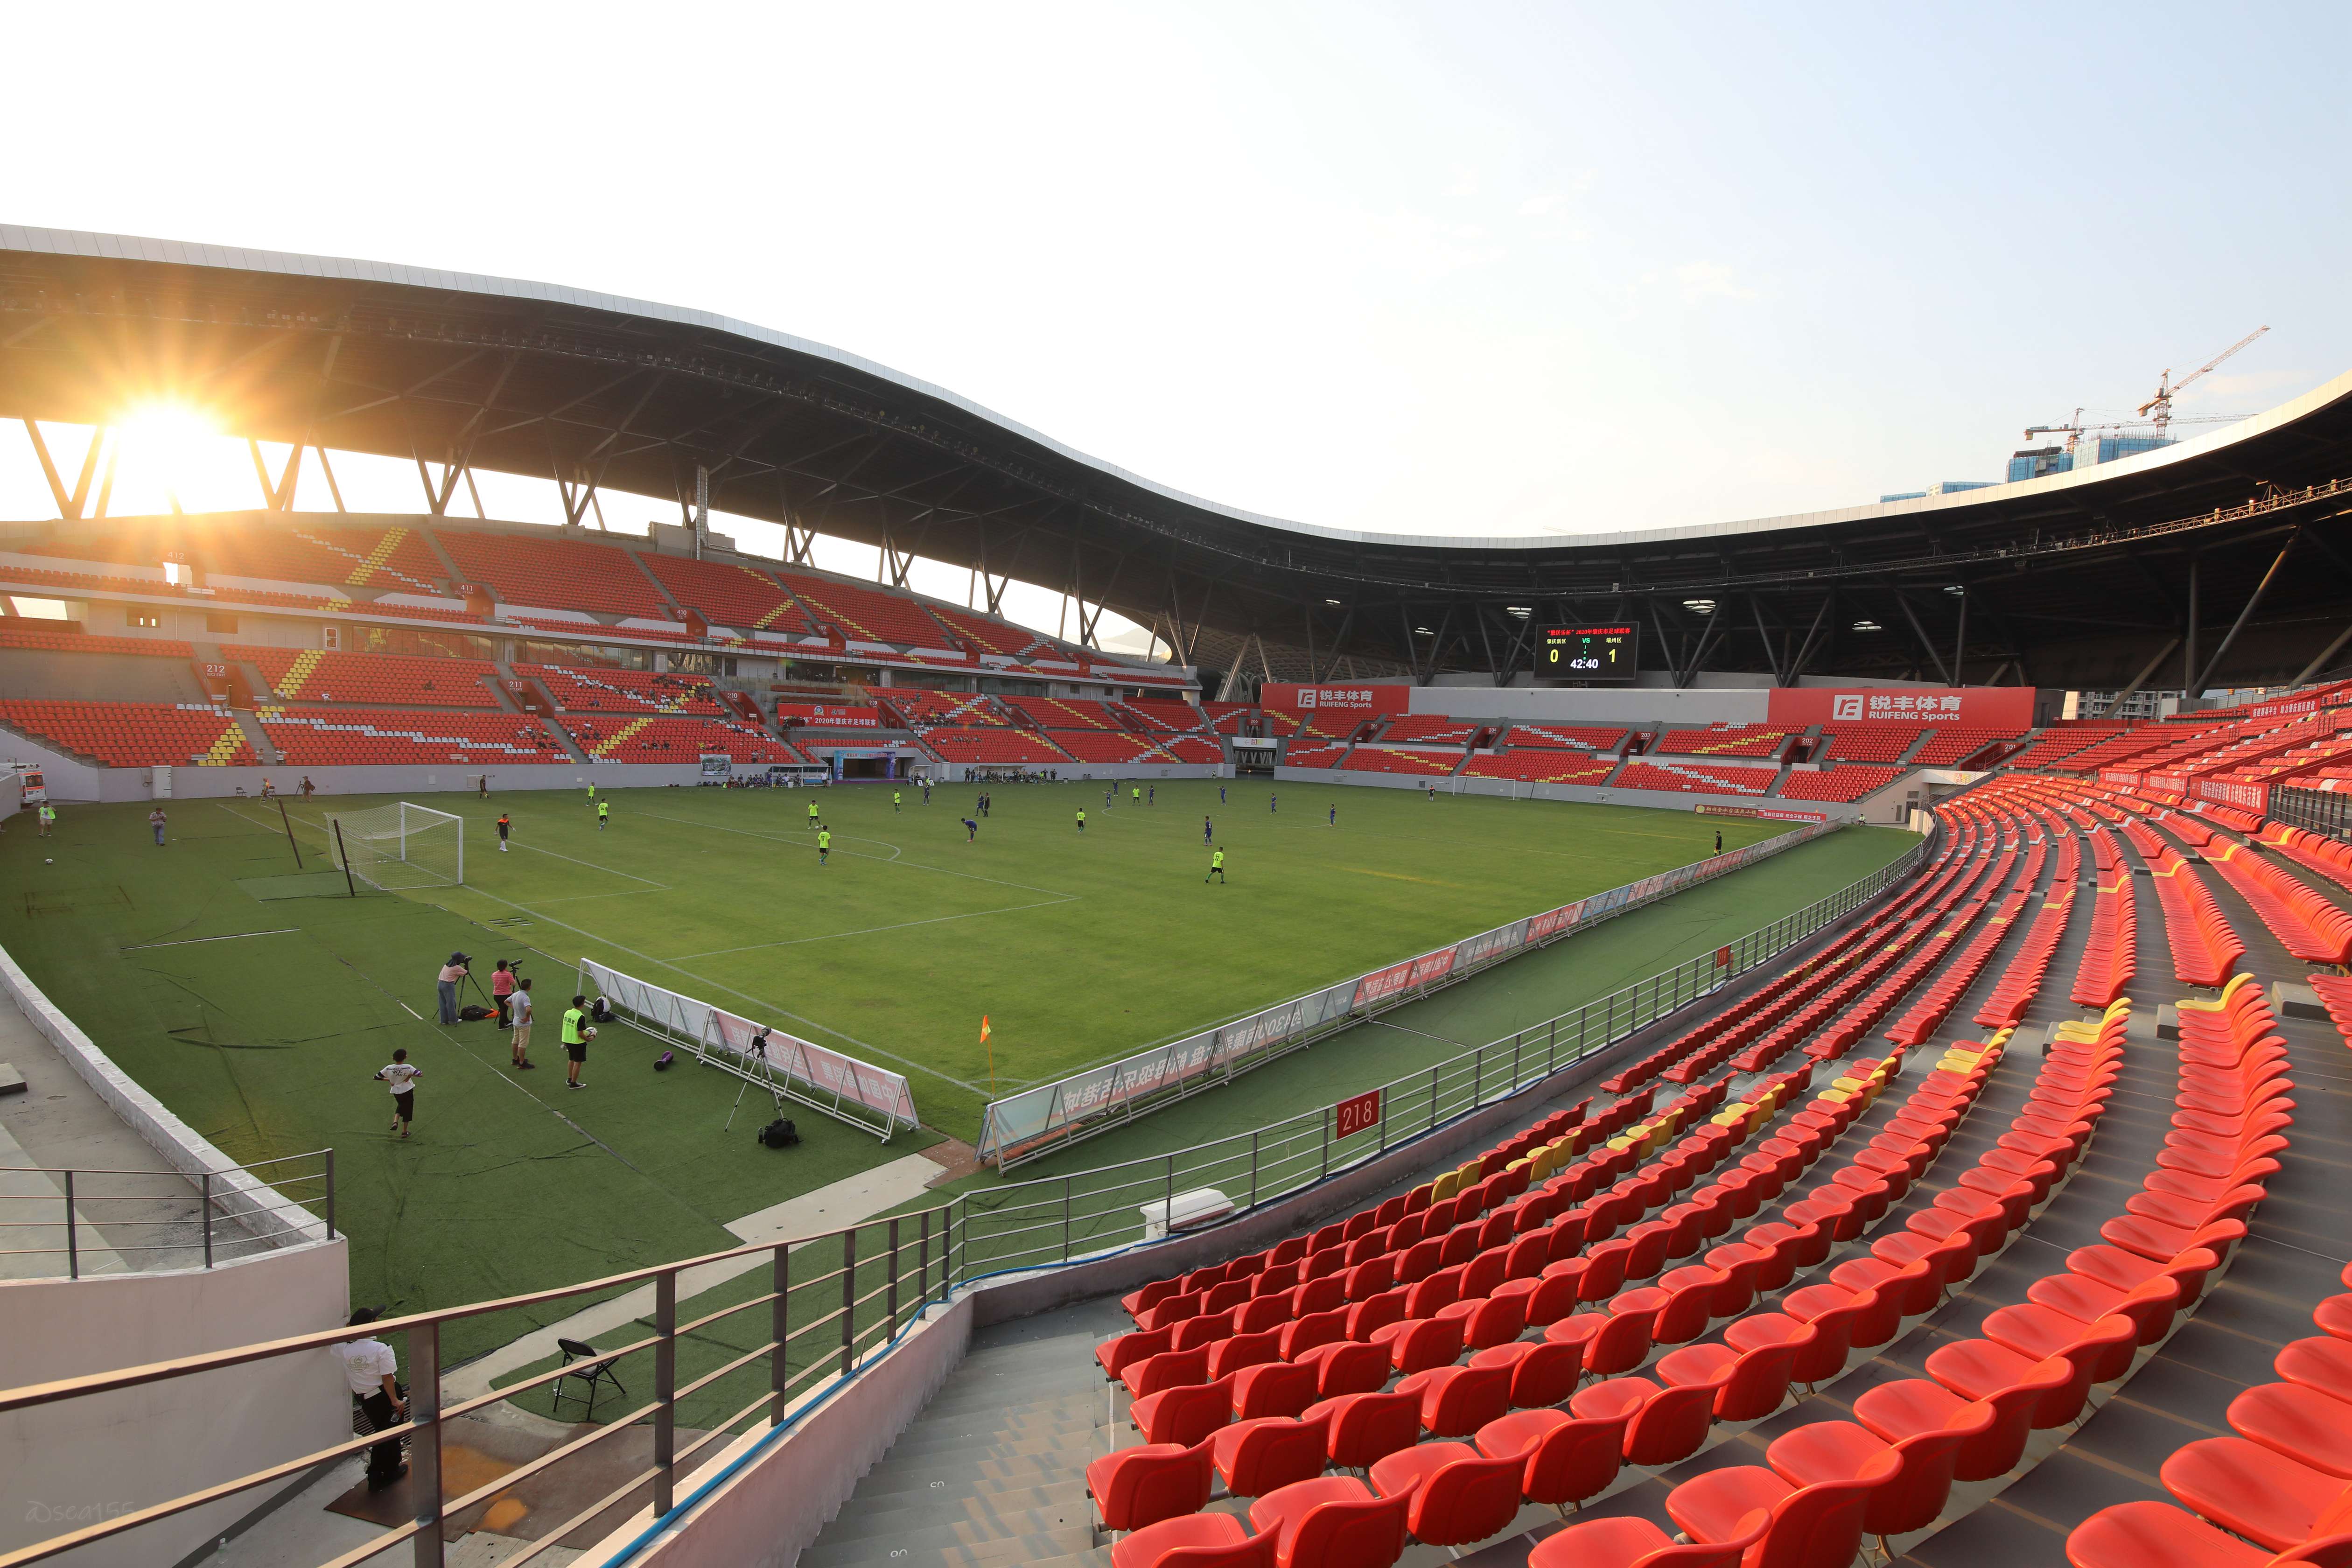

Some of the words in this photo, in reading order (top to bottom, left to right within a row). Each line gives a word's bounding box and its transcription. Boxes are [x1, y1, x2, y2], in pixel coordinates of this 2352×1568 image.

[168, 552, 184, 560] 412
[1550, 649, 1559, 663] 0
[1609, 649, 1616, 663] 1
[1570, 659, 1598, 669] 42:40
[1320, 690, 1373, 701] 锐丰体育
[1869, 695, 1962, 711] 锐丰体育
[815, 717, 876, 726] 2020年肇庆市足球联赛
[1869, 711, 1918, 720] RUIFENG
[1922, 712, 1960, 721] Sports
[1343, 1100, 1372, 1131] 218
